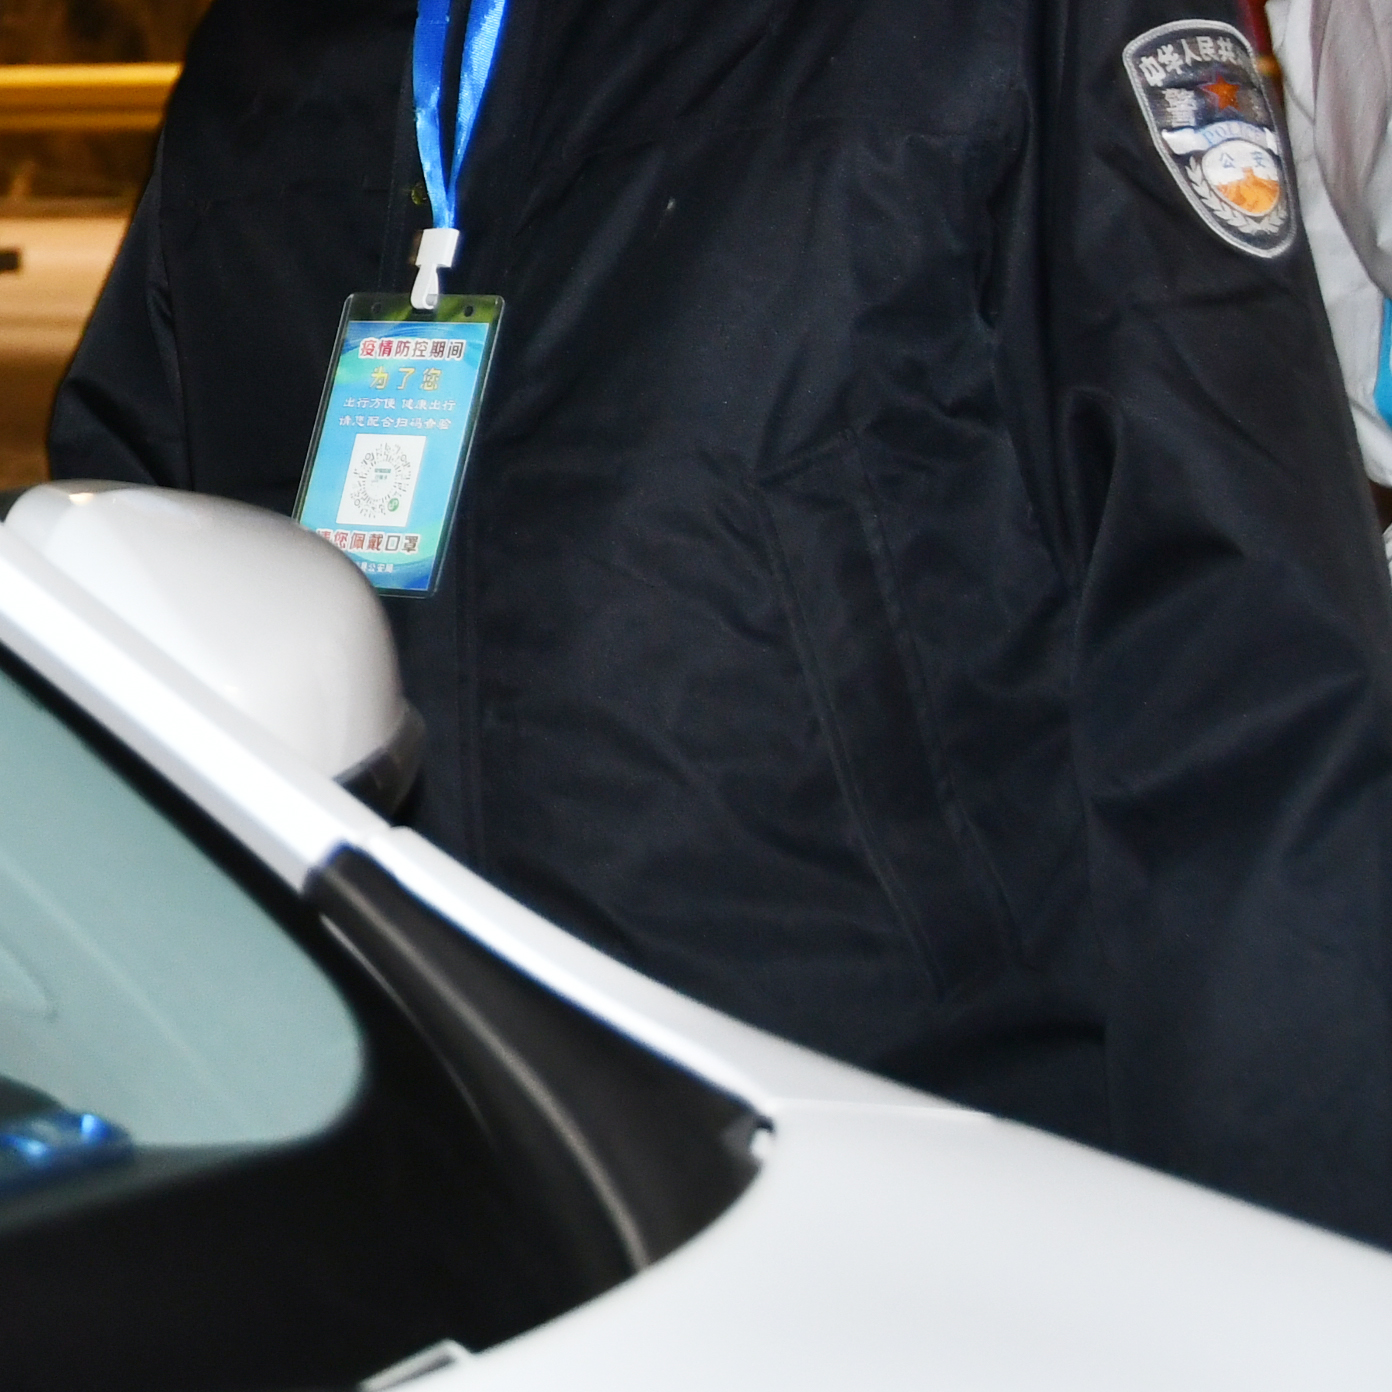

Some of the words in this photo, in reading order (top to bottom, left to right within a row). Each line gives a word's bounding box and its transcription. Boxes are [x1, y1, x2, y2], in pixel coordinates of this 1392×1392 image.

[1138, 36, 1252, 87] 中华人民共
[359, 339, 465, 359] 疫情防控期间
[369, 365, 444, 392] 为了您
[343, 397, 396, 410] 出行方便
[401, 398, 456, 411] 健康出行
[356, 563, 394, 574] 县公安局
